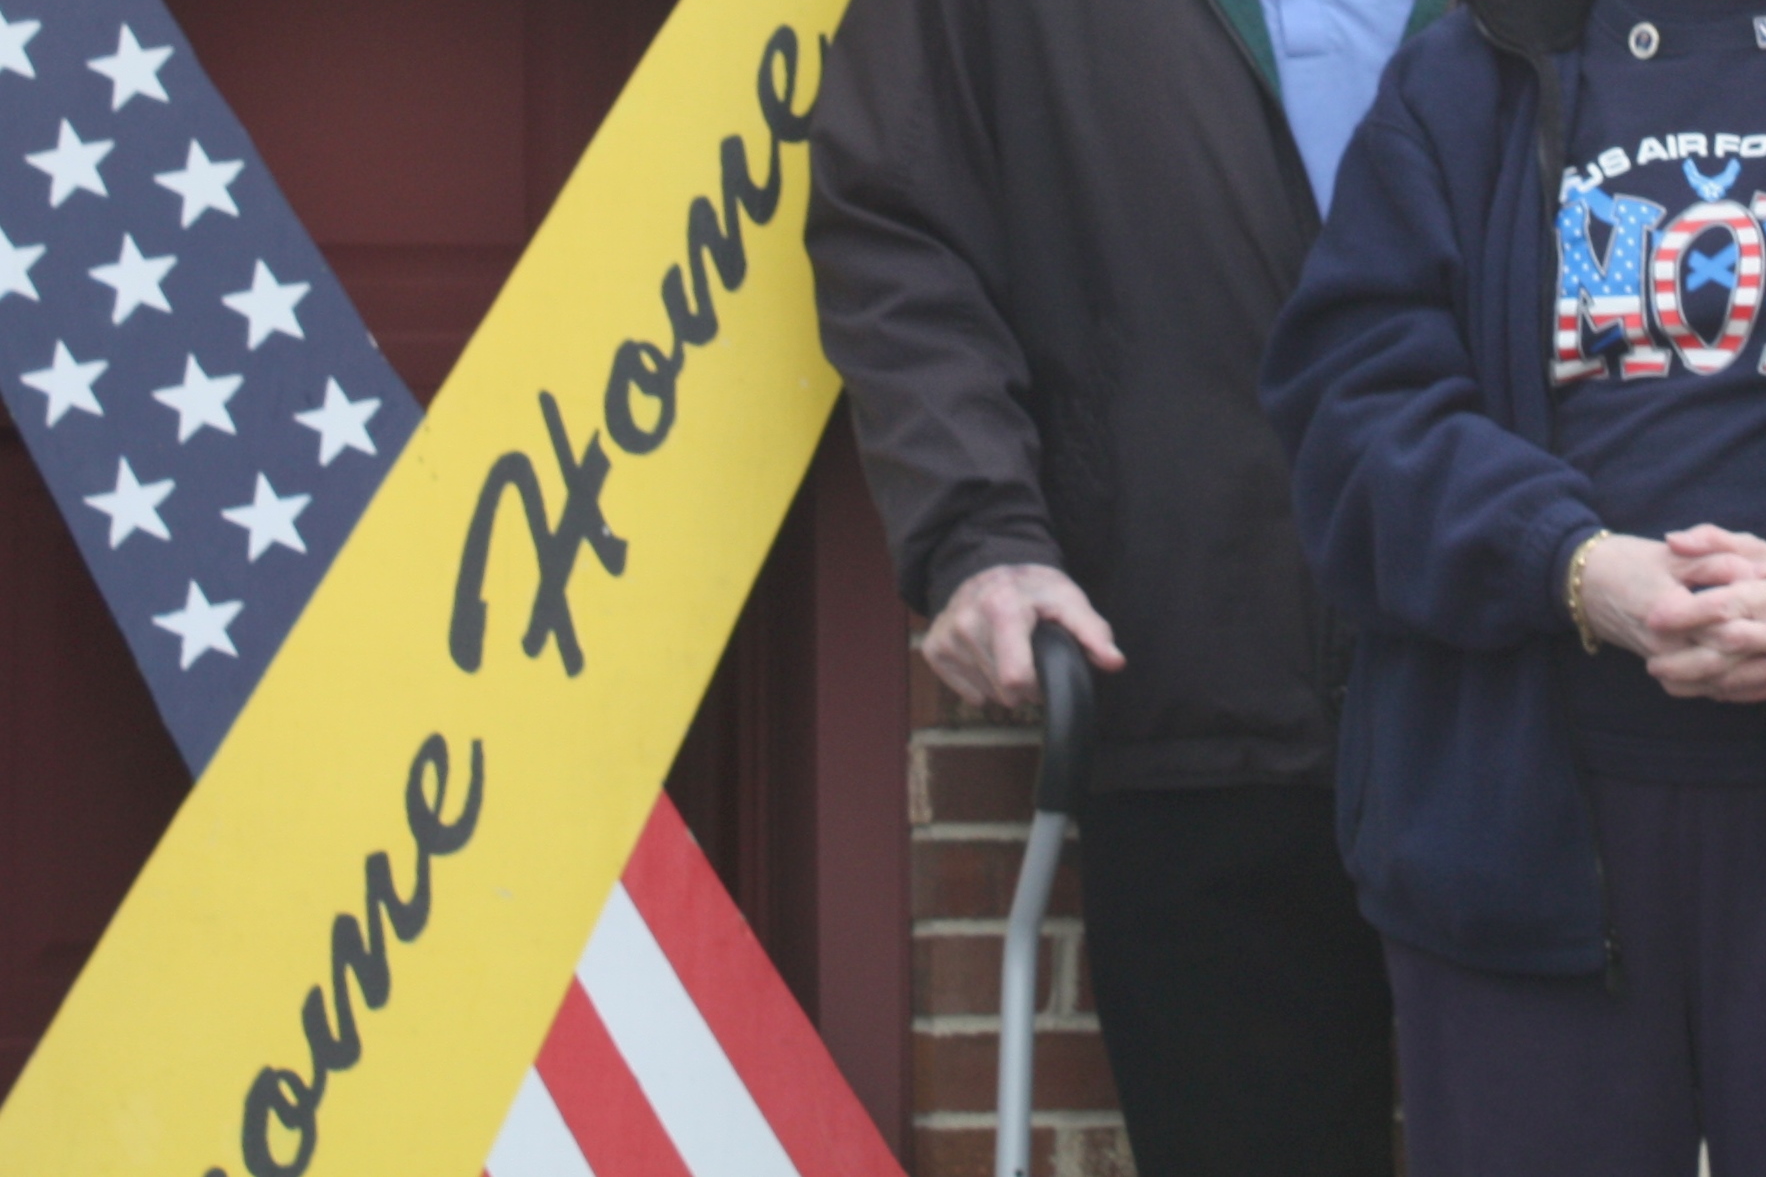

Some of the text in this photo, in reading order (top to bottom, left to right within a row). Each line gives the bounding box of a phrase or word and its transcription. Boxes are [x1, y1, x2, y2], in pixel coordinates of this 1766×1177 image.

[1636, 132, 1709, 166] AIR
[203, 23, 829, 1177] ome Home
